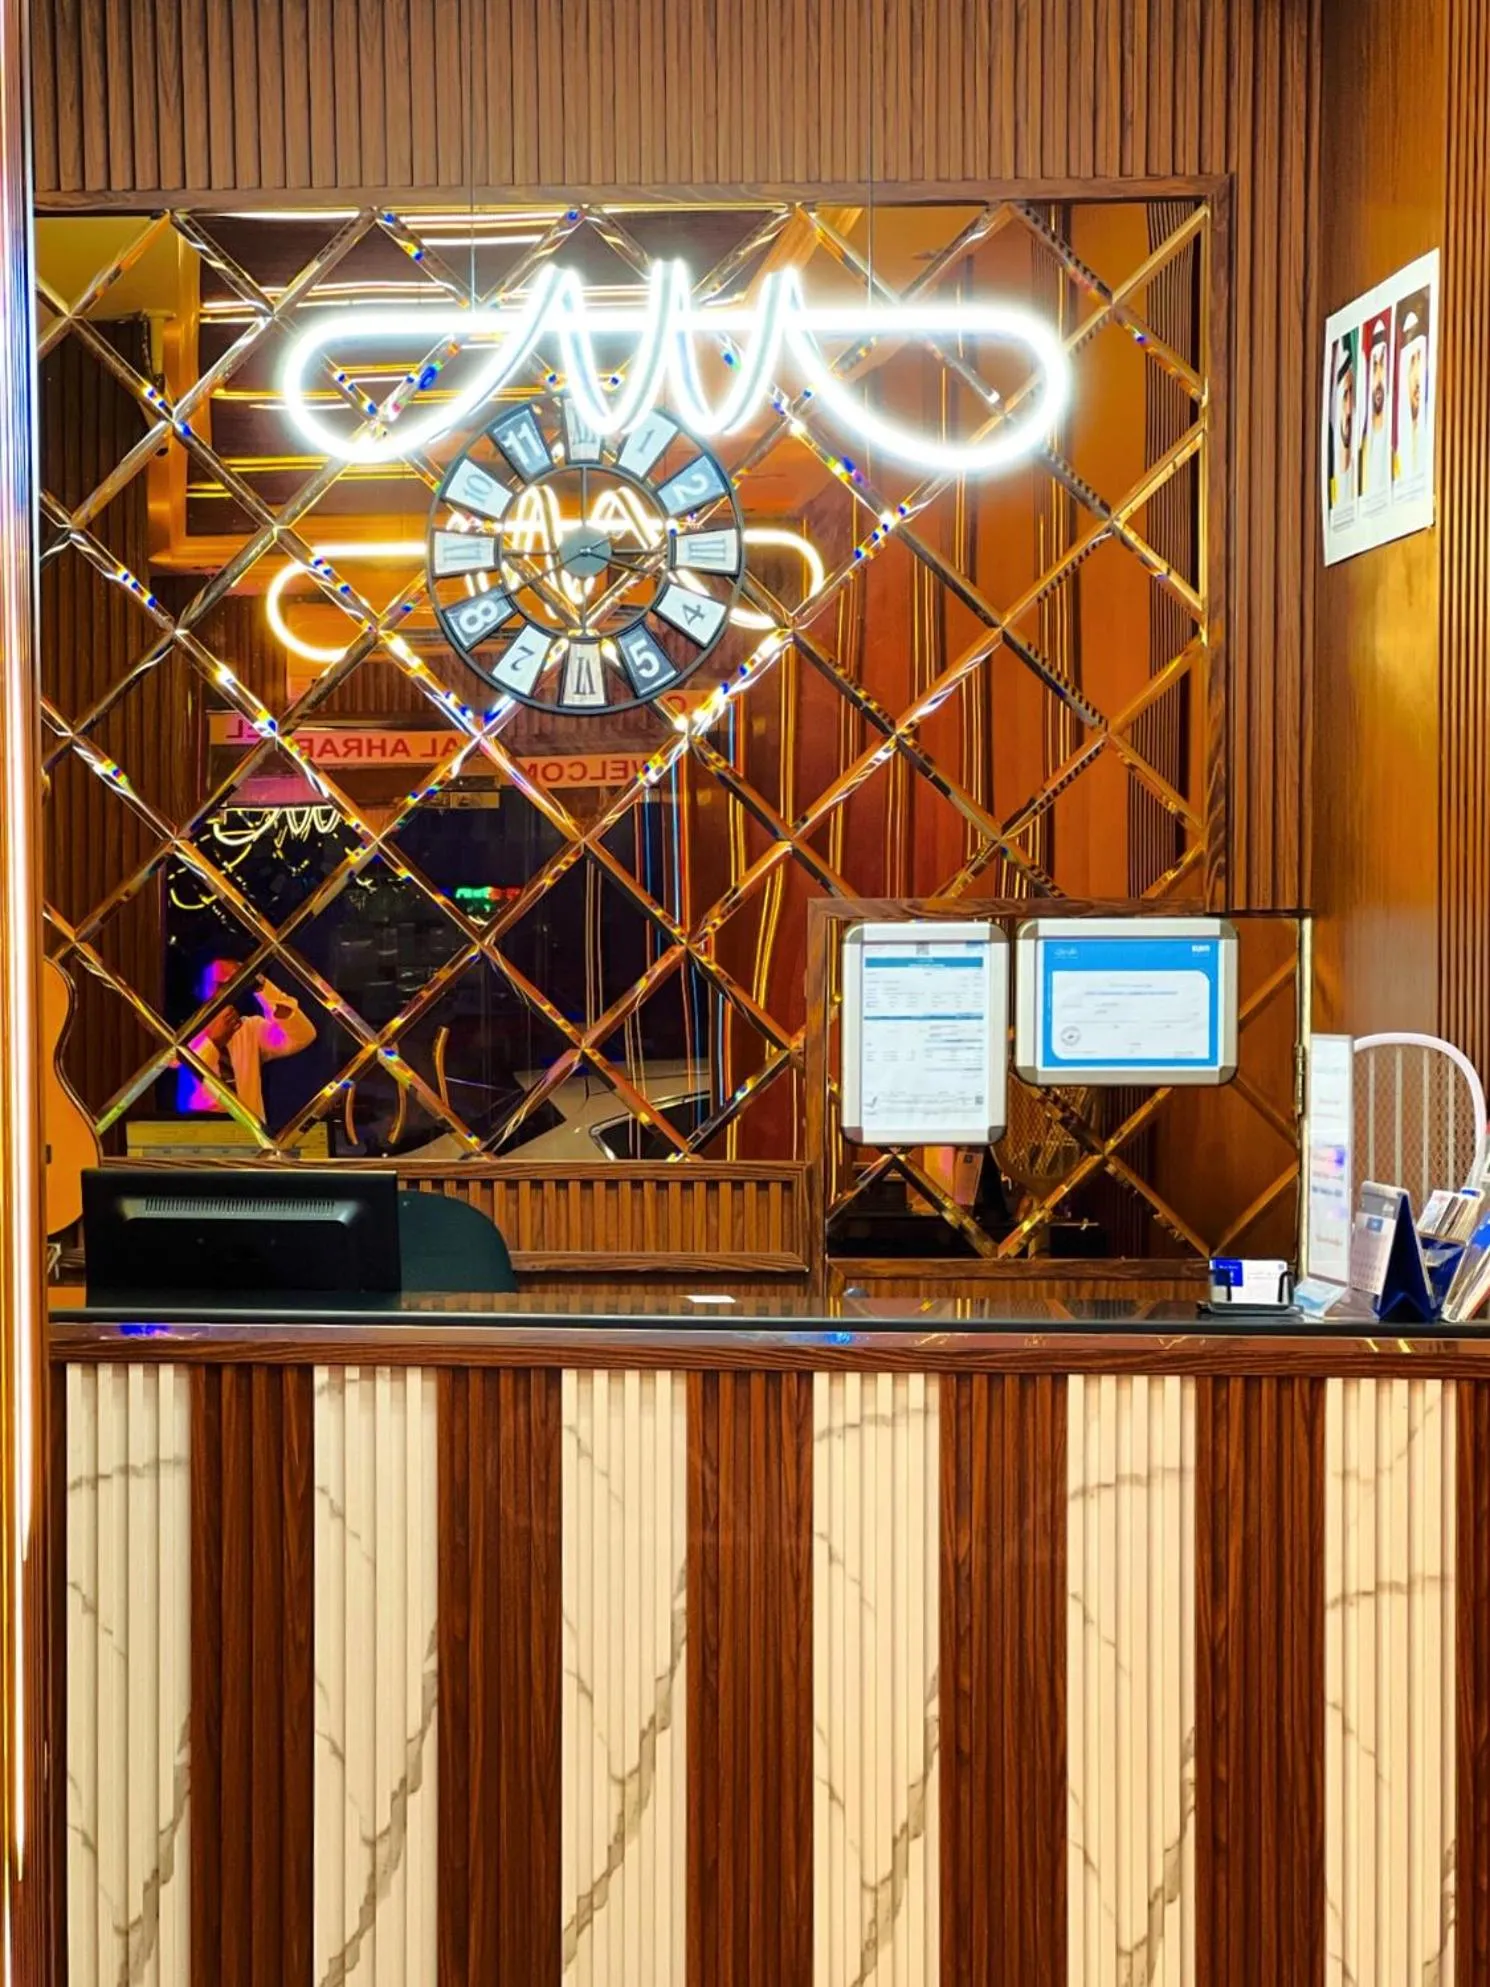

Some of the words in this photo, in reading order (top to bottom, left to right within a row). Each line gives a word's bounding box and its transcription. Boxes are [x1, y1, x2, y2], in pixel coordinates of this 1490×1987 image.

[501, 423, 539, 463] 11
[462, 474, 494, 506] 10
[671, 475, 709, 506] 2
[686, 538, 728, 562] III
[459, 600, 499, 628] 8
[680, 600, 706, 626] 4
[509, 645, 536, 672] 7
[629, 638, 660, 679] 5
[574, 657, 596, 695] VI
